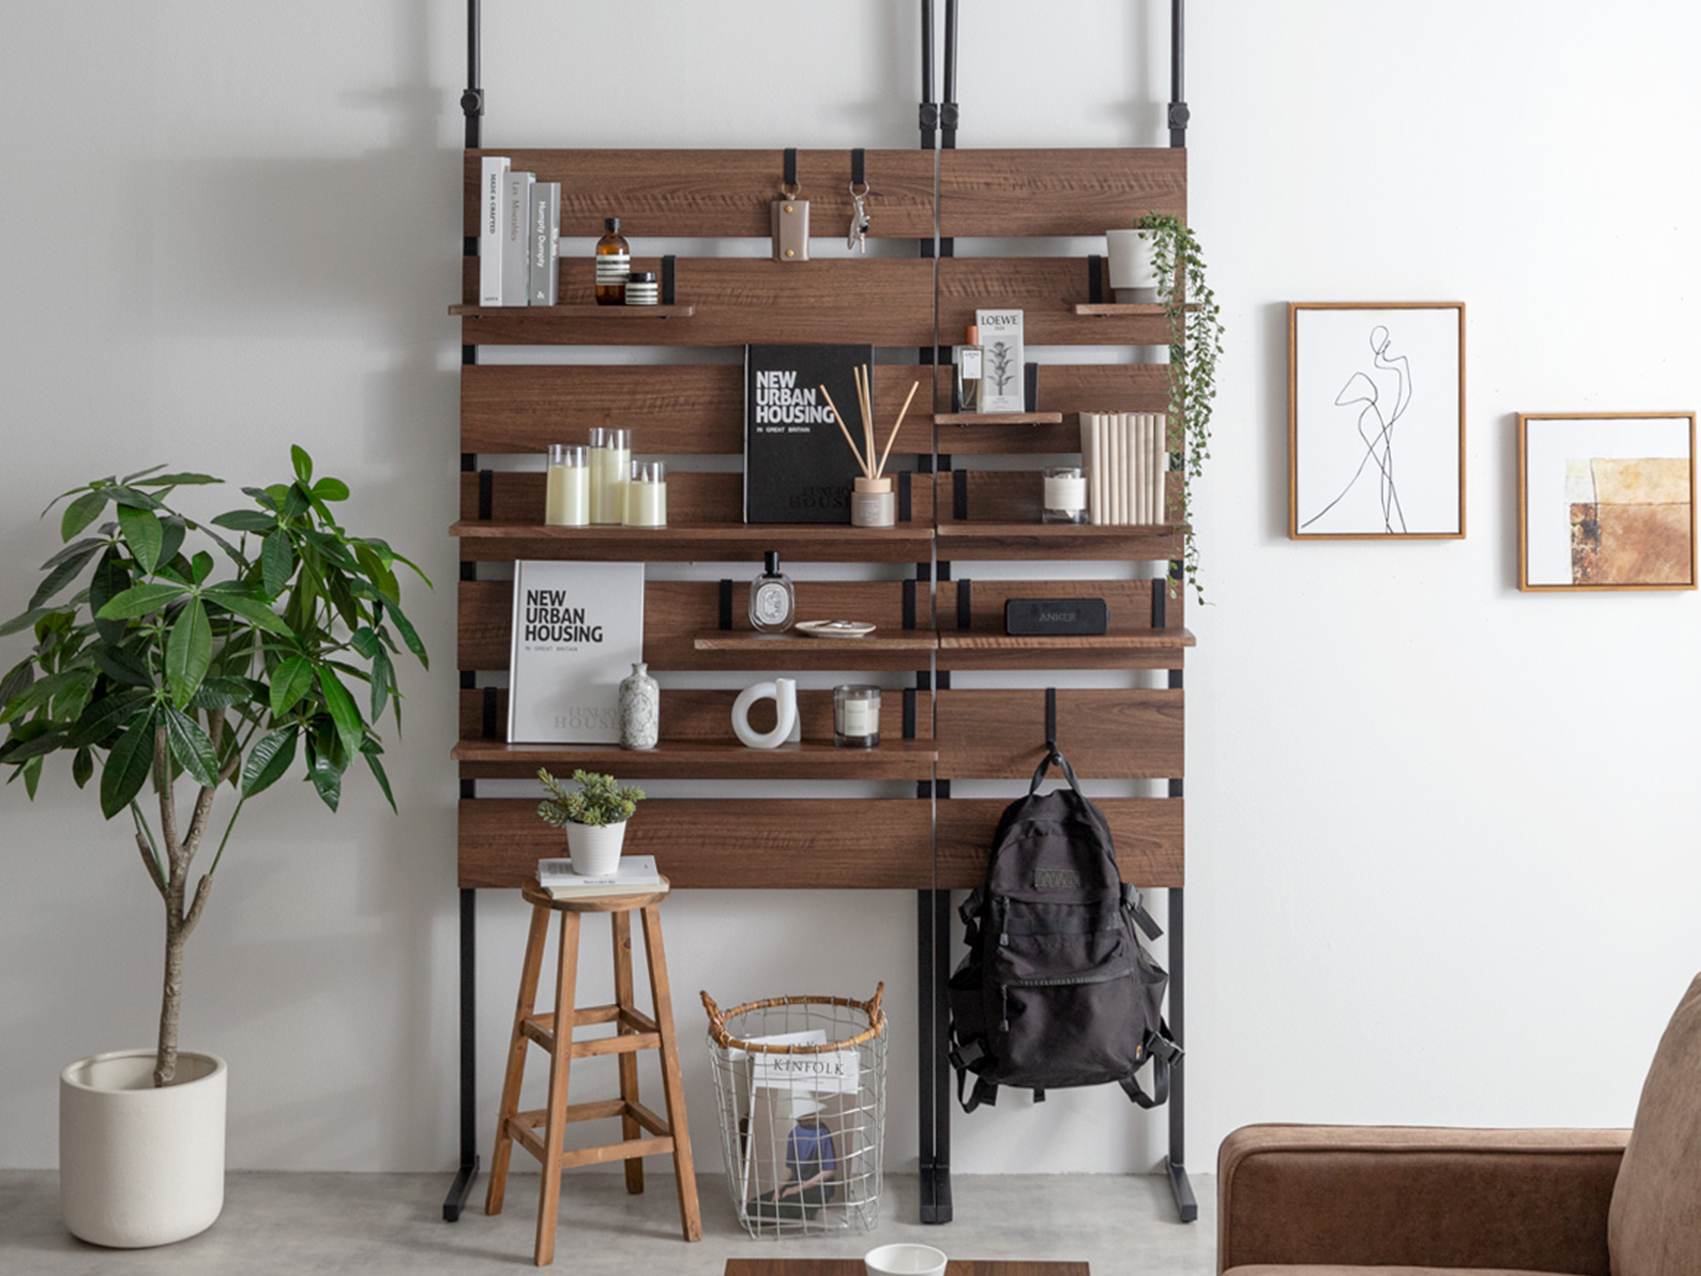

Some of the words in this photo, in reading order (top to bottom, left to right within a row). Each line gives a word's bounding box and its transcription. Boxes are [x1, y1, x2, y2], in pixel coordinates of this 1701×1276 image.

[512, 181, 521, 196] Les
[536, 201, 547, 234] Humpty
[536, 234, 546, 269] Dumpty
[981, 315, 1018, 326] LOEWE
[756, 371, 797, 388] NEW
[756, 388, 816, 406] URBAN
[756, 405, 835, 424] HOUSING
[789, 496, 850, 508] HOUS
[526, 589, 566, 607] NEW
[526, 607, 585, 625] URBAN
[1039, 612, 1076, 622] ANKER
[525, 625, 603, 643] HOUSING
[773, 1058, 845, 1076] KINFOLK
